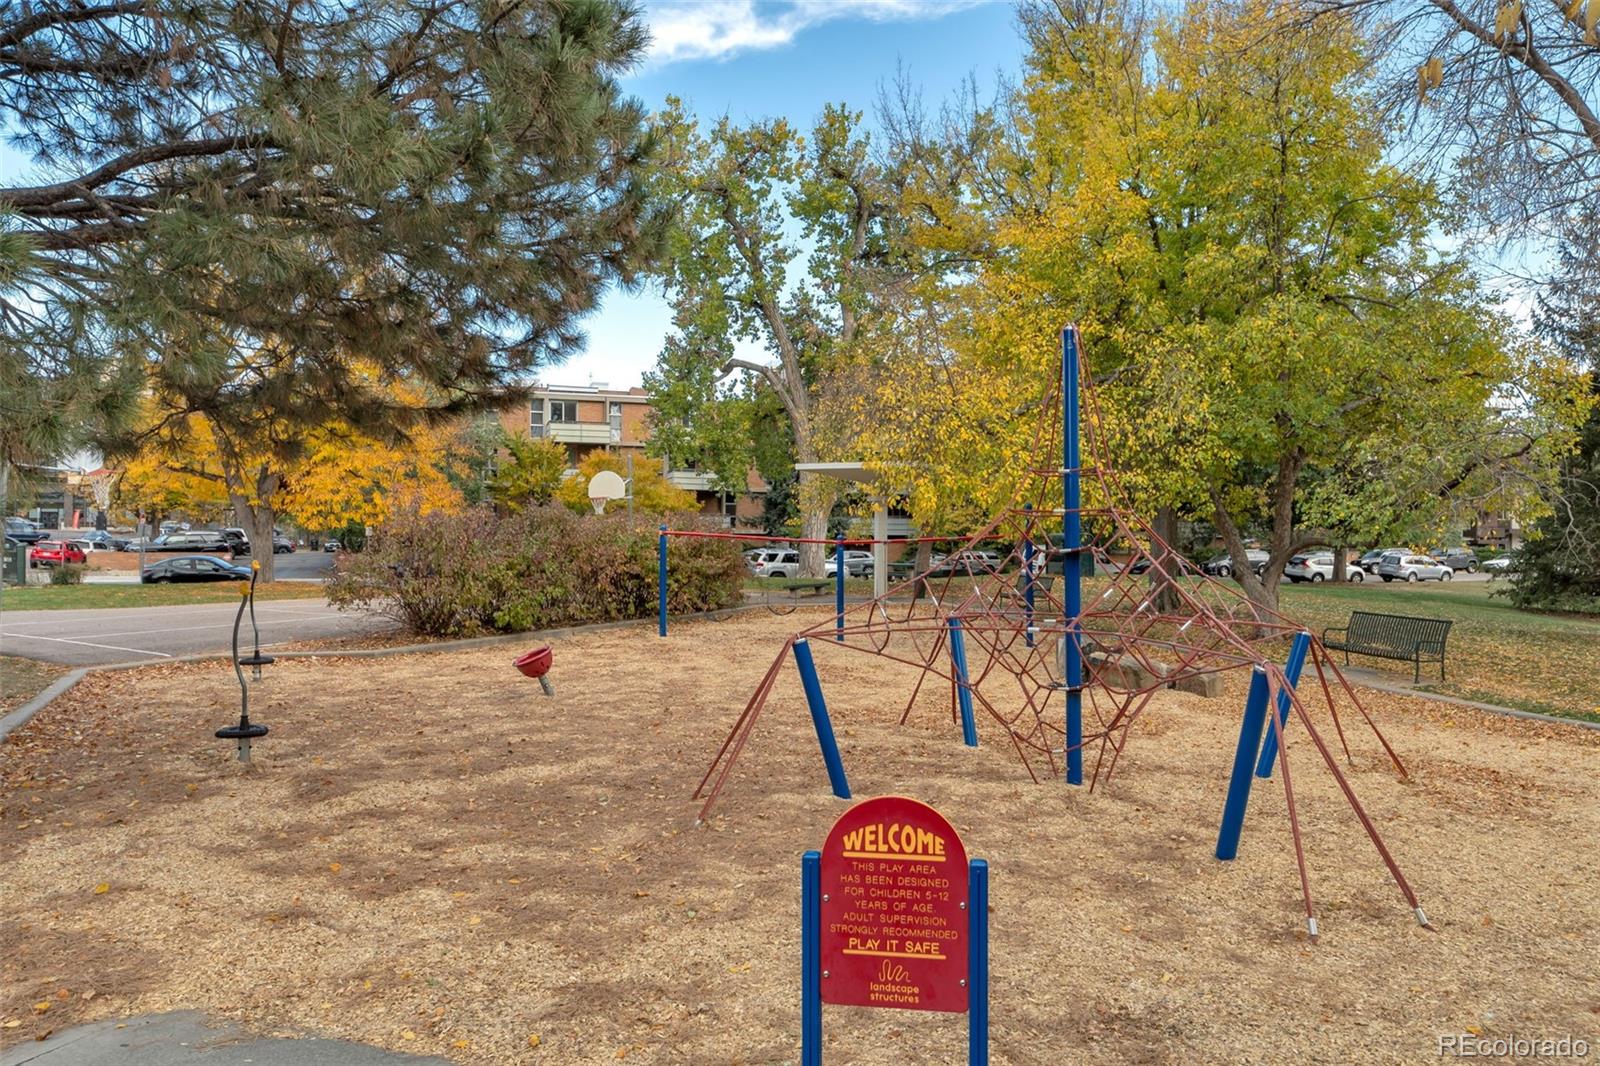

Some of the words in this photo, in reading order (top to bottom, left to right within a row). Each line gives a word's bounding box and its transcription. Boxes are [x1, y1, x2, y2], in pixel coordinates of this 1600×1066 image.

[843, 823, 945, 855] WELCOME
[853, 861, 875, 871] THIS
[879, 863, 904, 873] PLAY
[909, 865, 937, 874] AREA
[840, 874, 861, 883] HAS
[865, 876, 893, 885] BEEN
[898, 876, 949, 888] DESIGNED
[844, 887, 865, 896] FOR
[869, 888, 921, 900] CHILDREN
[925, 890, 949, 900] 5-12
[854, 900, 888, 911] YEARS
[893, 902, 907, 911] OF
[912, 903, 937, 913] AGE.
[843, 913, 874, 922] ADULT
[879, 914, 947, 926] SUPERVISION
[830, 924, 878, 935] STRONGLY
[883, 927, 958, 940] RECOMMENDED
[849, 938, 880, 950] PLAY
[886, 940, 899, 951] IT
[905, 941, 940, 954] SAFE
[870, 982, 919, 994] landscape
[870, 993, 919, 1004] structures
